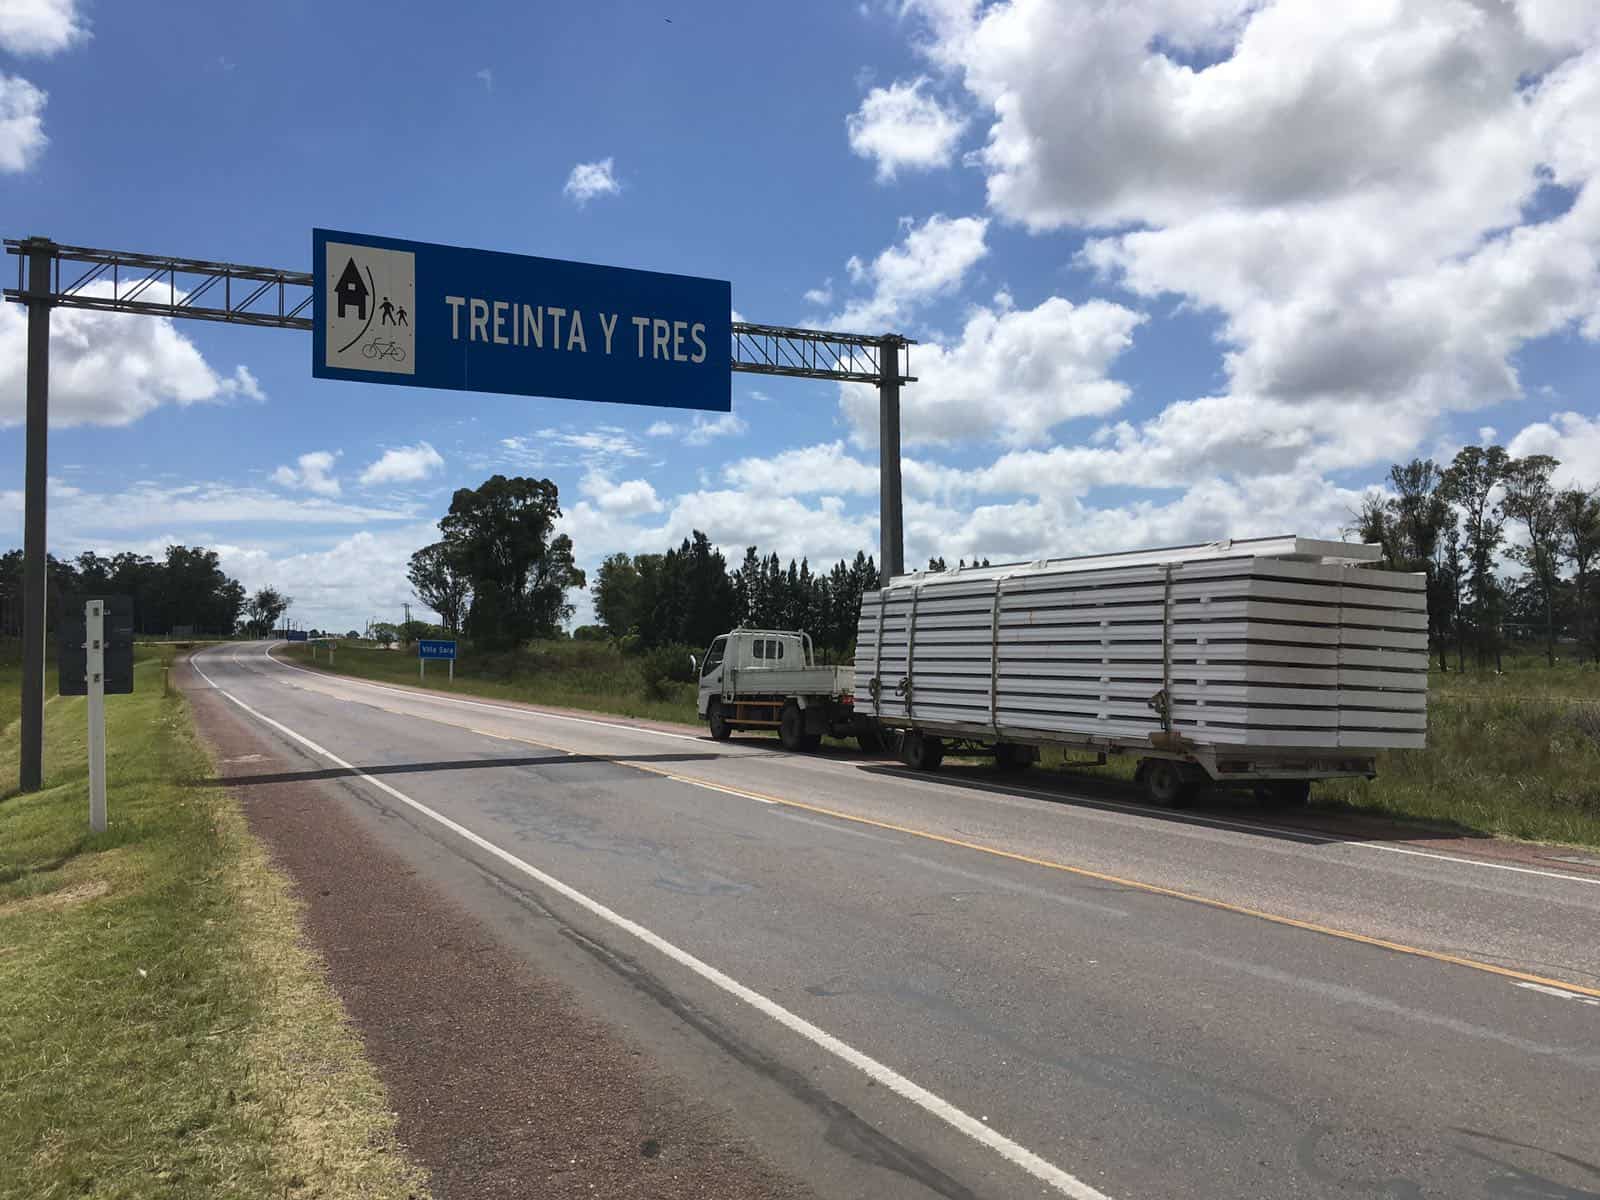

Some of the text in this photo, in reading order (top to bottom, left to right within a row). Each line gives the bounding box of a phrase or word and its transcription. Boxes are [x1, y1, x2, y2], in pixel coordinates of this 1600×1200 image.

[445, 295, 706, 364] TREINTA Y TRES
